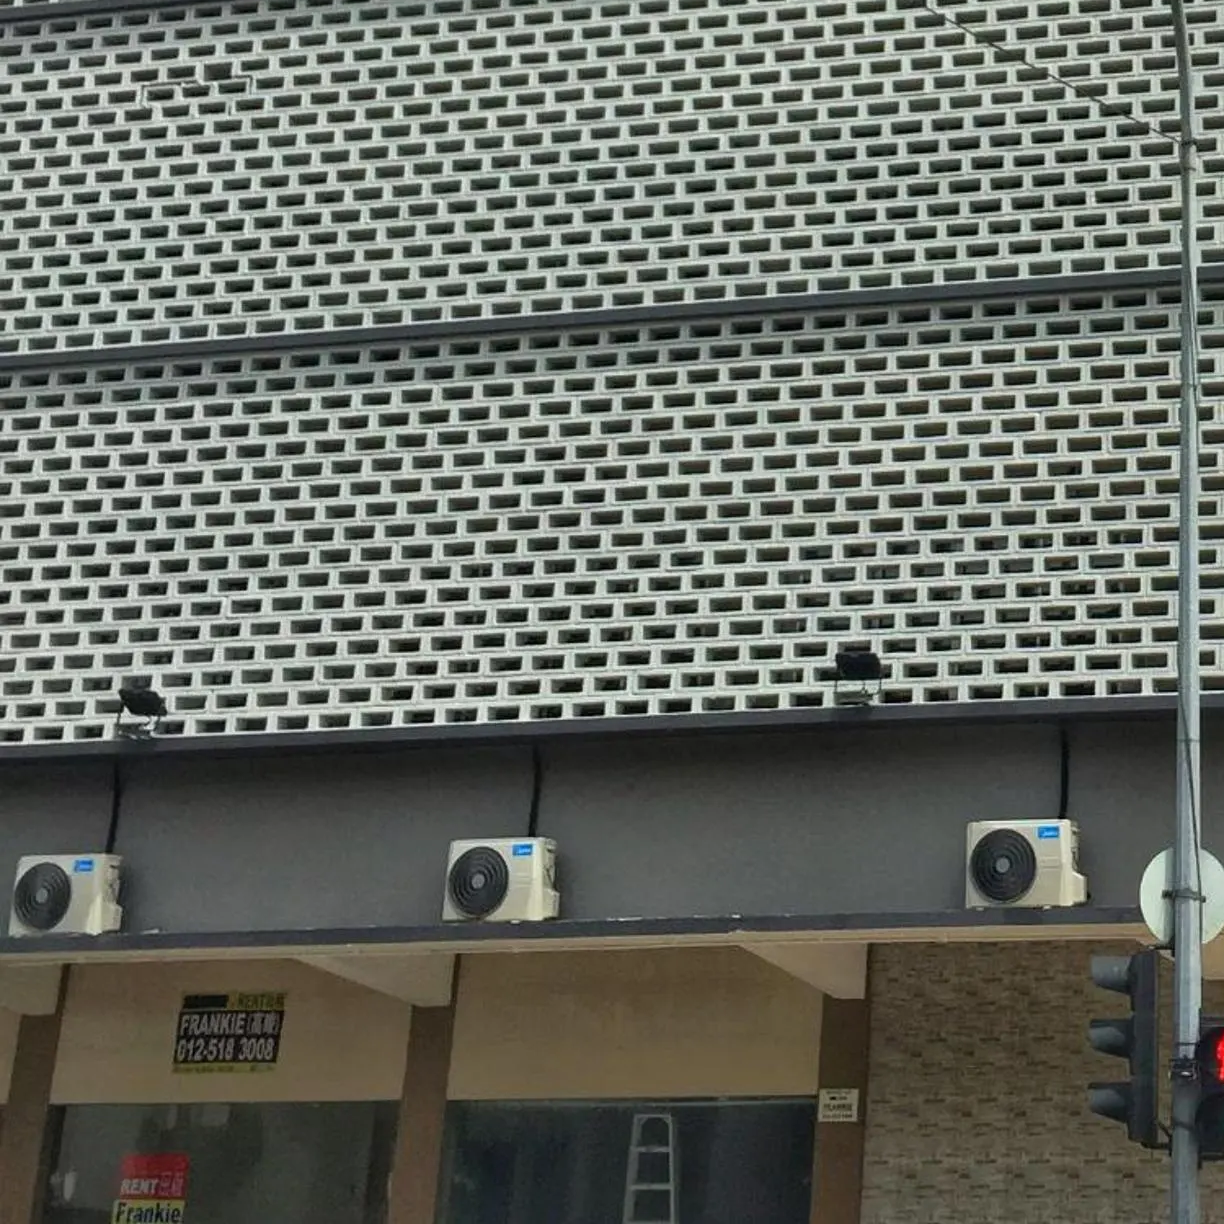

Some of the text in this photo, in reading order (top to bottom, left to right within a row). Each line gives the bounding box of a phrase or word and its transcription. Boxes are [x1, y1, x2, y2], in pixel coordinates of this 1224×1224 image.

[180, 1013, 246, 1036] FRANKIE
[177, 1036, 275, 1062] 012-518 3008
[120, 1178, 158, 1196] RENT
[115, 1202, 182, 1224] Frankie
